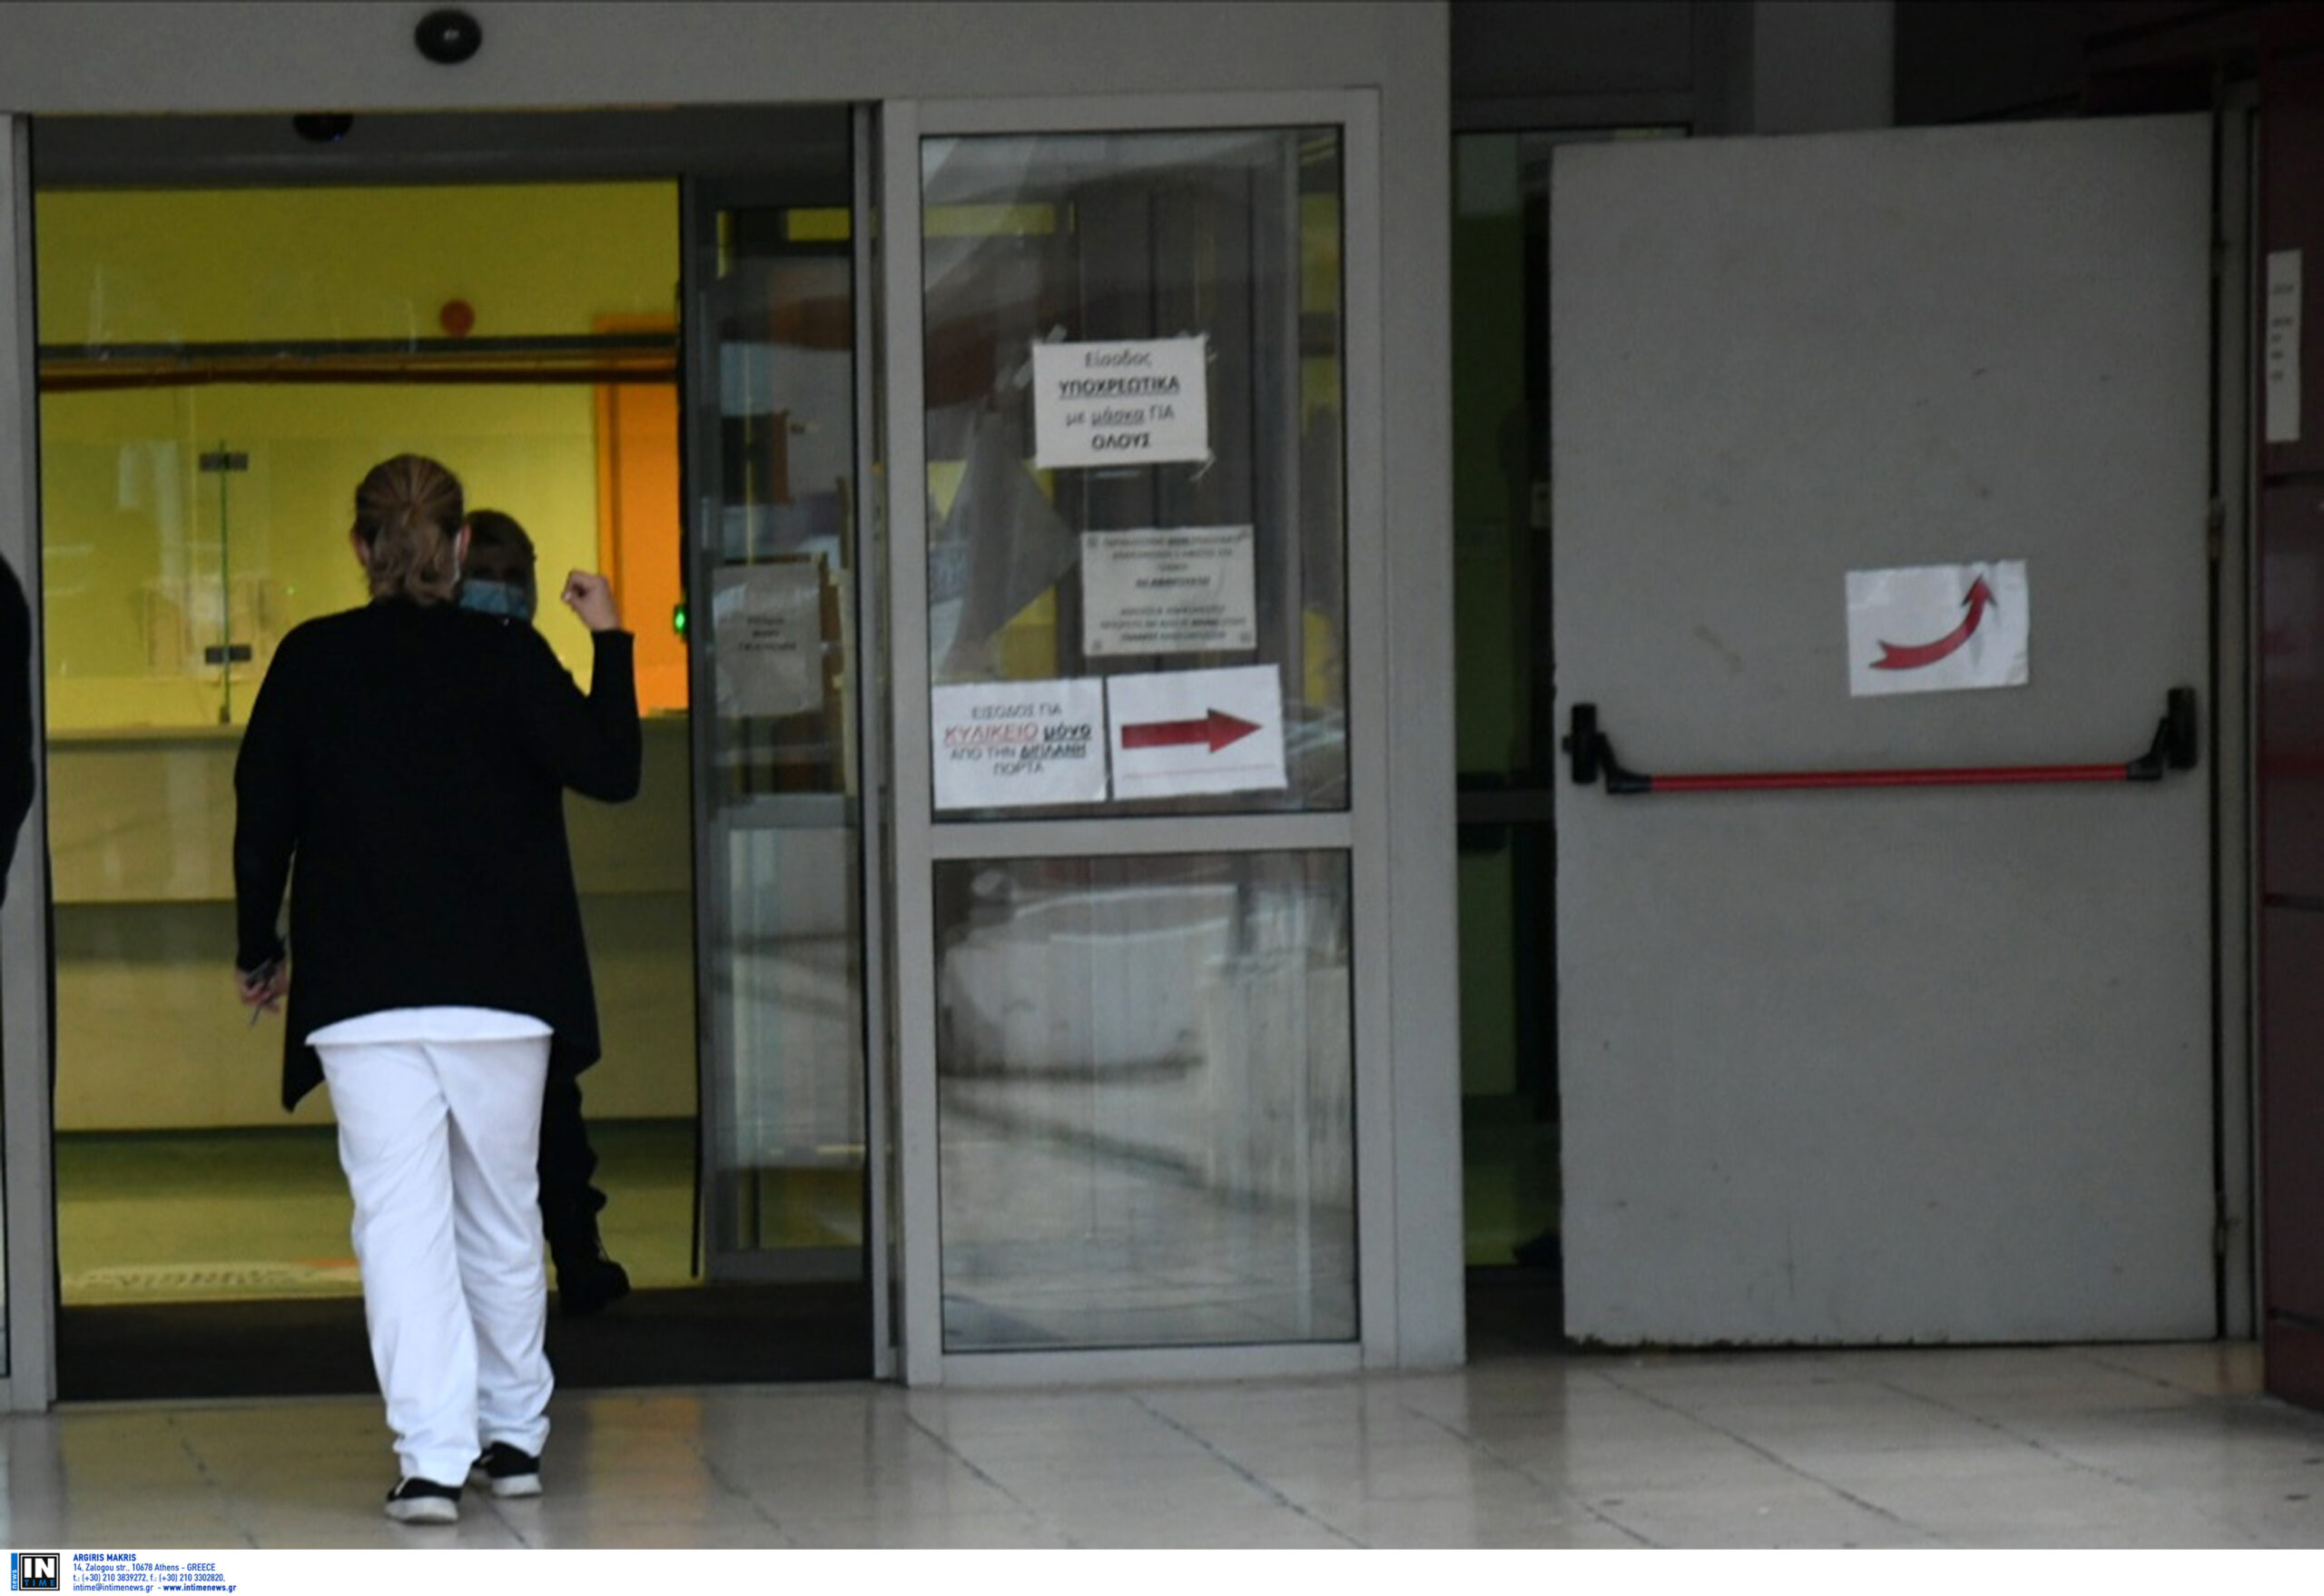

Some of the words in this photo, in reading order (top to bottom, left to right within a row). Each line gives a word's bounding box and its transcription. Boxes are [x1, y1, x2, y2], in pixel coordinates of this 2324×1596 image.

[1059, 375, 1180, 398] ΥΠΟΧΡΕΩΤΙΚΑ
[1066, 411, 1086, 427] με
[1091, 407, 1146, 427] μάσκα
[1150, 404, 1176, 421] ΓΙΑ
[1091, 433, 1151, 450] ΟΛΟΥΣ
[970, 704, 1035, 721] ΕΙΣΟΔΟΣ
[1039, 702, 1063, 717] ΓΙΑ
[944, 723, 1039, 745] ΚΥΛΙΚΕΙΟ
